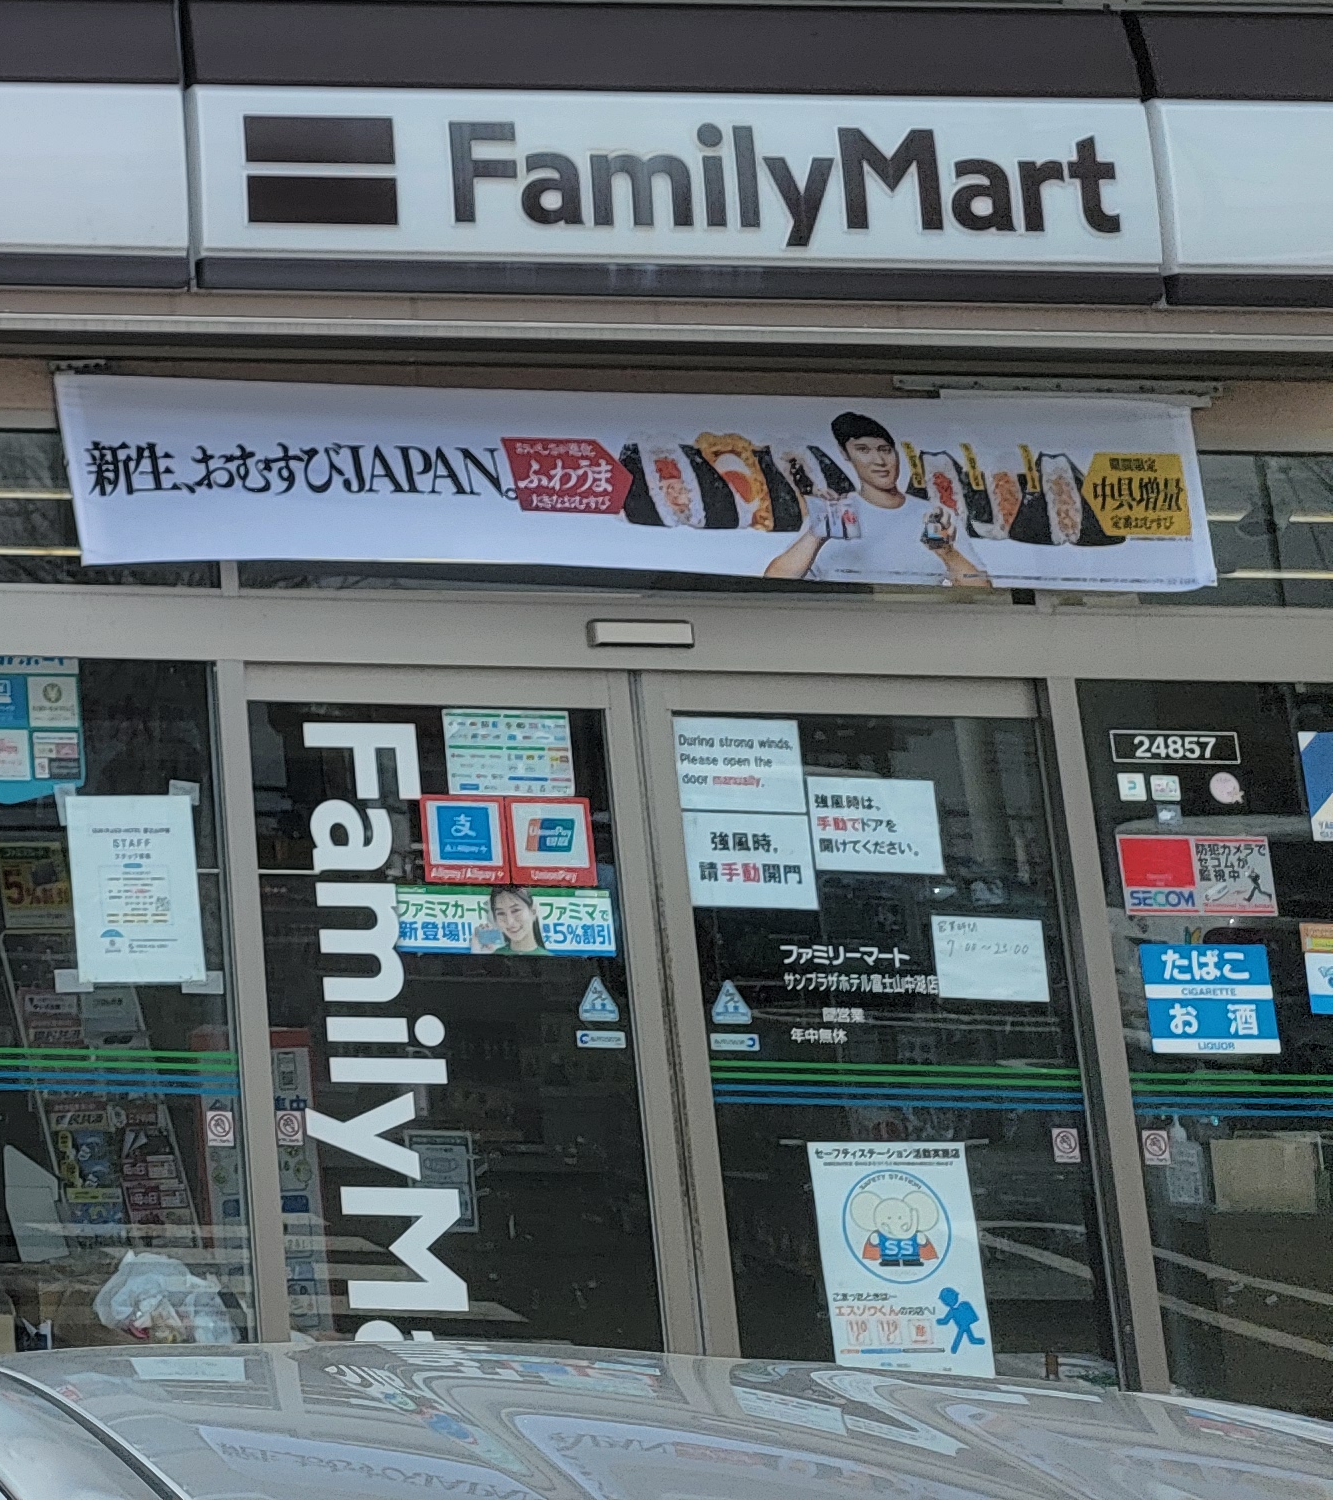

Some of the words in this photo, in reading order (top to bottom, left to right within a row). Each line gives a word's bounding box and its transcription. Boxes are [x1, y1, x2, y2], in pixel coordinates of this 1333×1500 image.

[446, 120, 1122, 248] FamilyMart
[518, 459, 613, 493] ふわうま
[1092, 476, 1184, 513] 中具増量
[678, 734, 714, 748] During
[718, 736, 754, 749] strong
[1133, 735, 1216, 759] 24857
[680, 754, 719, 767] Please
[722, 757, 750, 768] open
[754, 756, 773, 768] the
[682, 774, 708, 785] door
[816, 816, 898, 833] 手動でドアを
[819, 837, 919, 856] 開けてください。
[1195, 842, 1266, 857] 防犯カメラで
[1198, 856, 1249, 869] セコムが
[699, 861, 803, 884] 請手動開門
[1199, 869, 1240, 882] 監視中
[1129, 890, 1195, 907] SECOM
[399, 900, 489, 919] ファミマカード
[539, 901, 610, 922] ファミマで
[399, 921, 473, 942] 新登場!!
[779, 944, 911, 967] ファミリーマート
[1161, 949, 1250, 980] たばこ
[1181, 987, 1237, 997] CIGARETTE
[303, 721, 469, 1342] FamilyM
[790, 1027, 848, 1044] 年中無休
[1198, 1041, 1236, 1051] LIQUOR
[884, 1240, 914, 1255] SS
